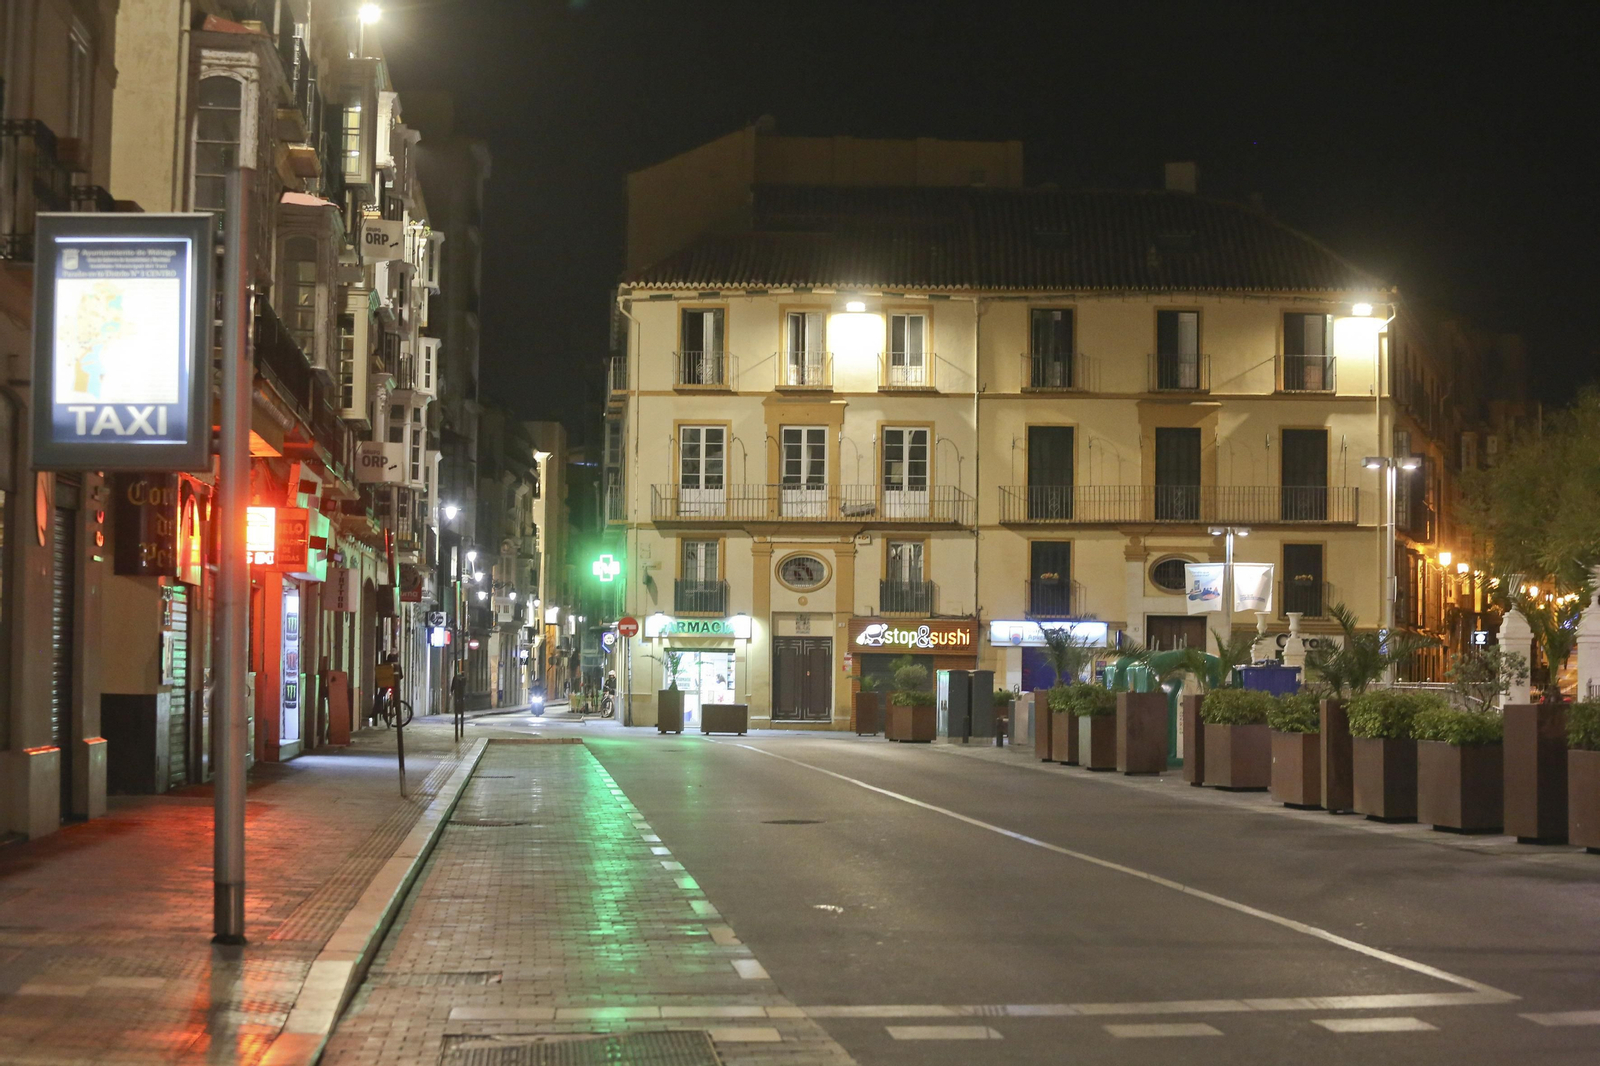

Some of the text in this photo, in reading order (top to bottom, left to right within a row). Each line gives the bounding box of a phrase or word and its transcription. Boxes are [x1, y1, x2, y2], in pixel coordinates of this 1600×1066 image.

[366, 232, 389, 245] ORP
[68, 406, 168, 436] TAXI
[362, 455, 388, 468] ORP
